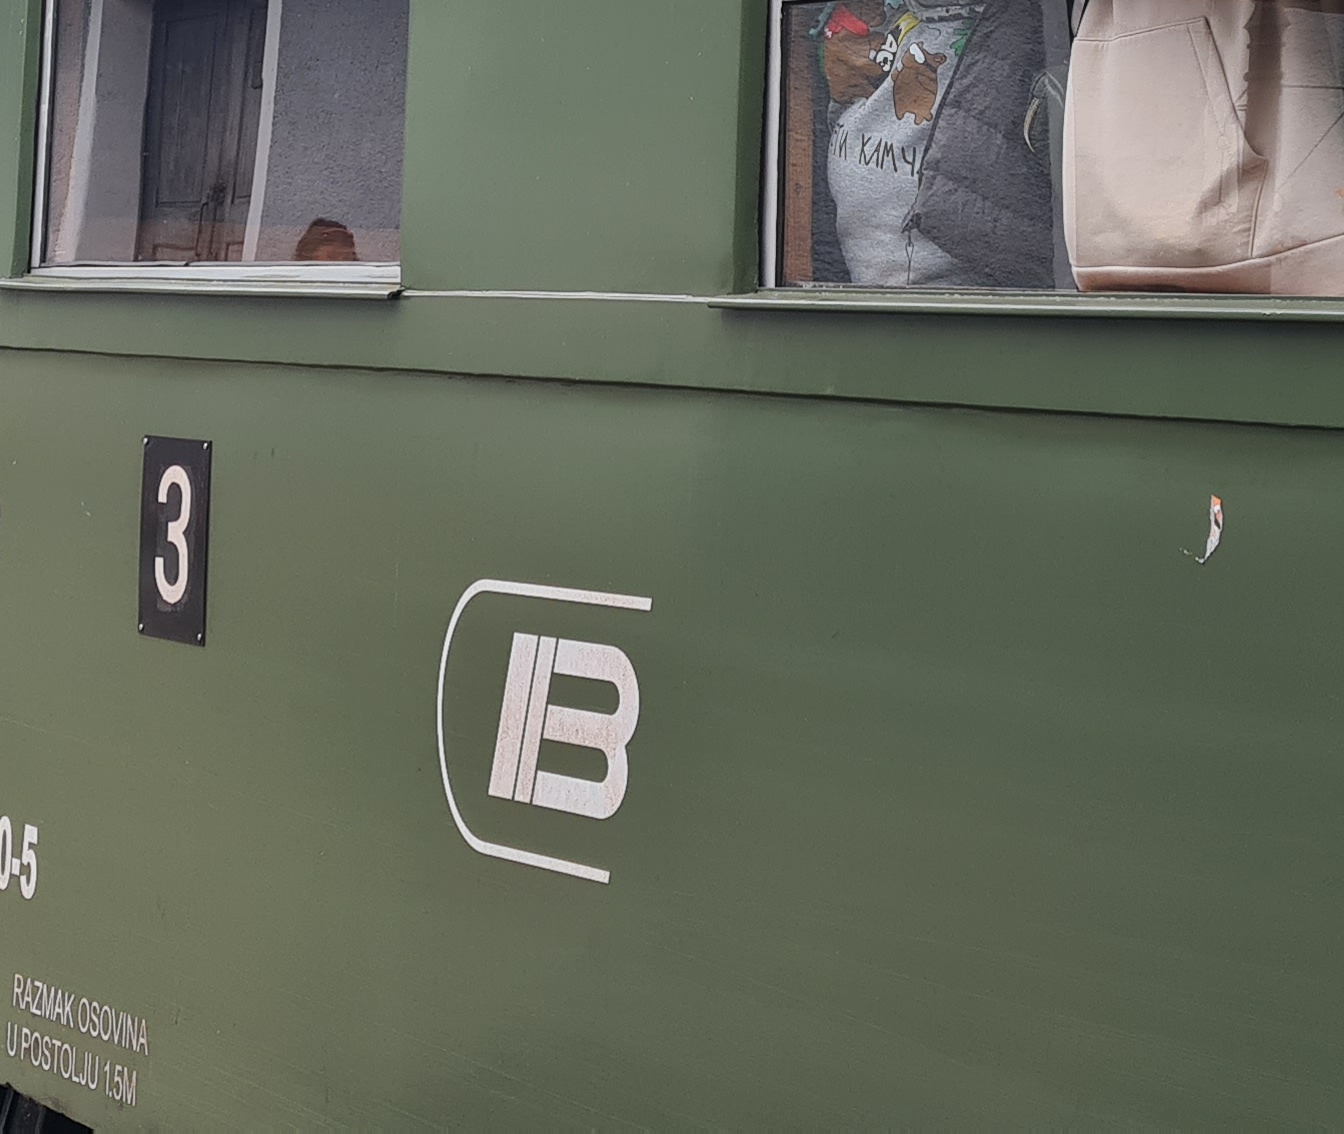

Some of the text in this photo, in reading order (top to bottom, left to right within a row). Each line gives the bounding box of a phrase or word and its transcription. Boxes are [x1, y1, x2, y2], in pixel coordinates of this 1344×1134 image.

[858, 133, 921, 178] КАМЧ
[154, 464, 192, 604] 3
[12, 973, 149, 1056] RAZMAK OSOVINA
[6, 1021, 137, 1107] U POSTOLJU 1.5M
